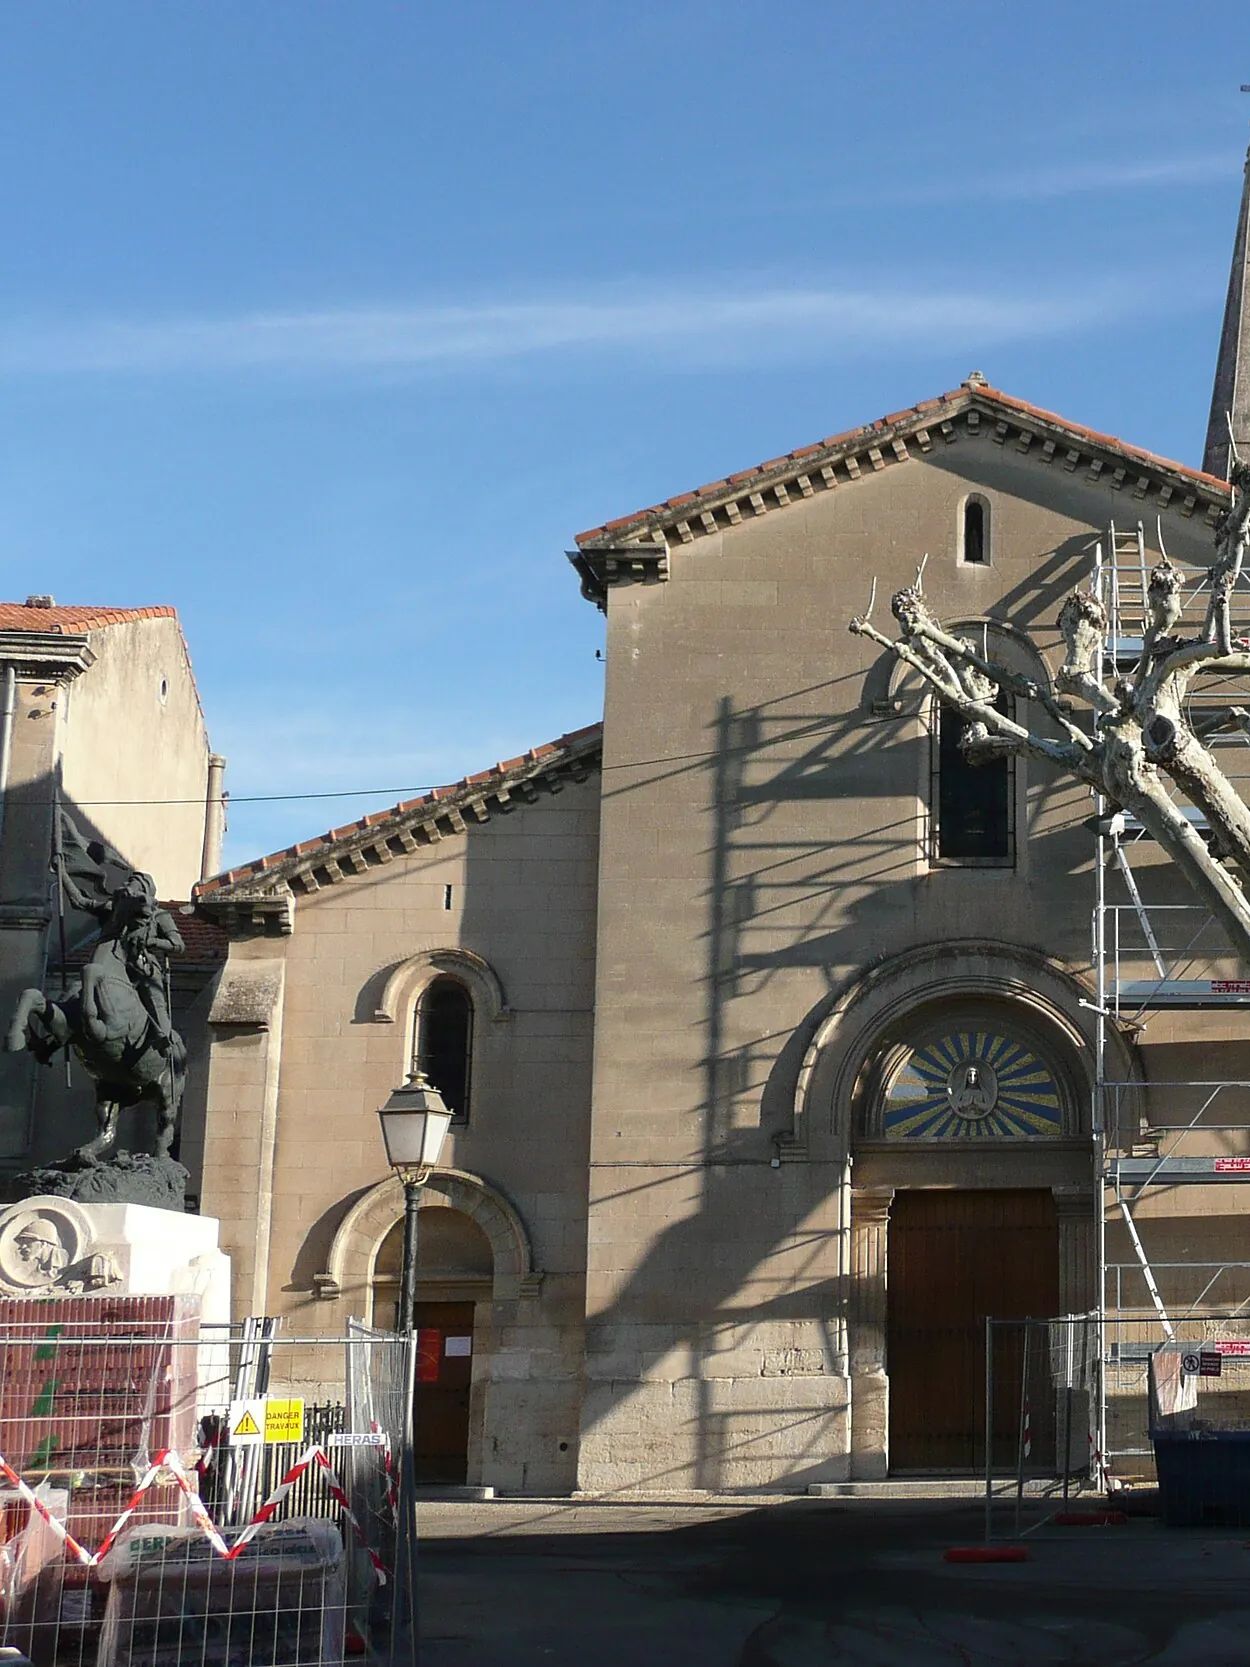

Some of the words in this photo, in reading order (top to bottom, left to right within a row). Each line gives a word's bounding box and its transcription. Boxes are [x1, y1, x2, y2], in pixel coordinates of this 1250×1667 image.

[266, 1411, 300, 1420] DANGER
[265, 1422, 299, 1431] TRAVAUX
[334, 1435, 380, 1445] HERAS
